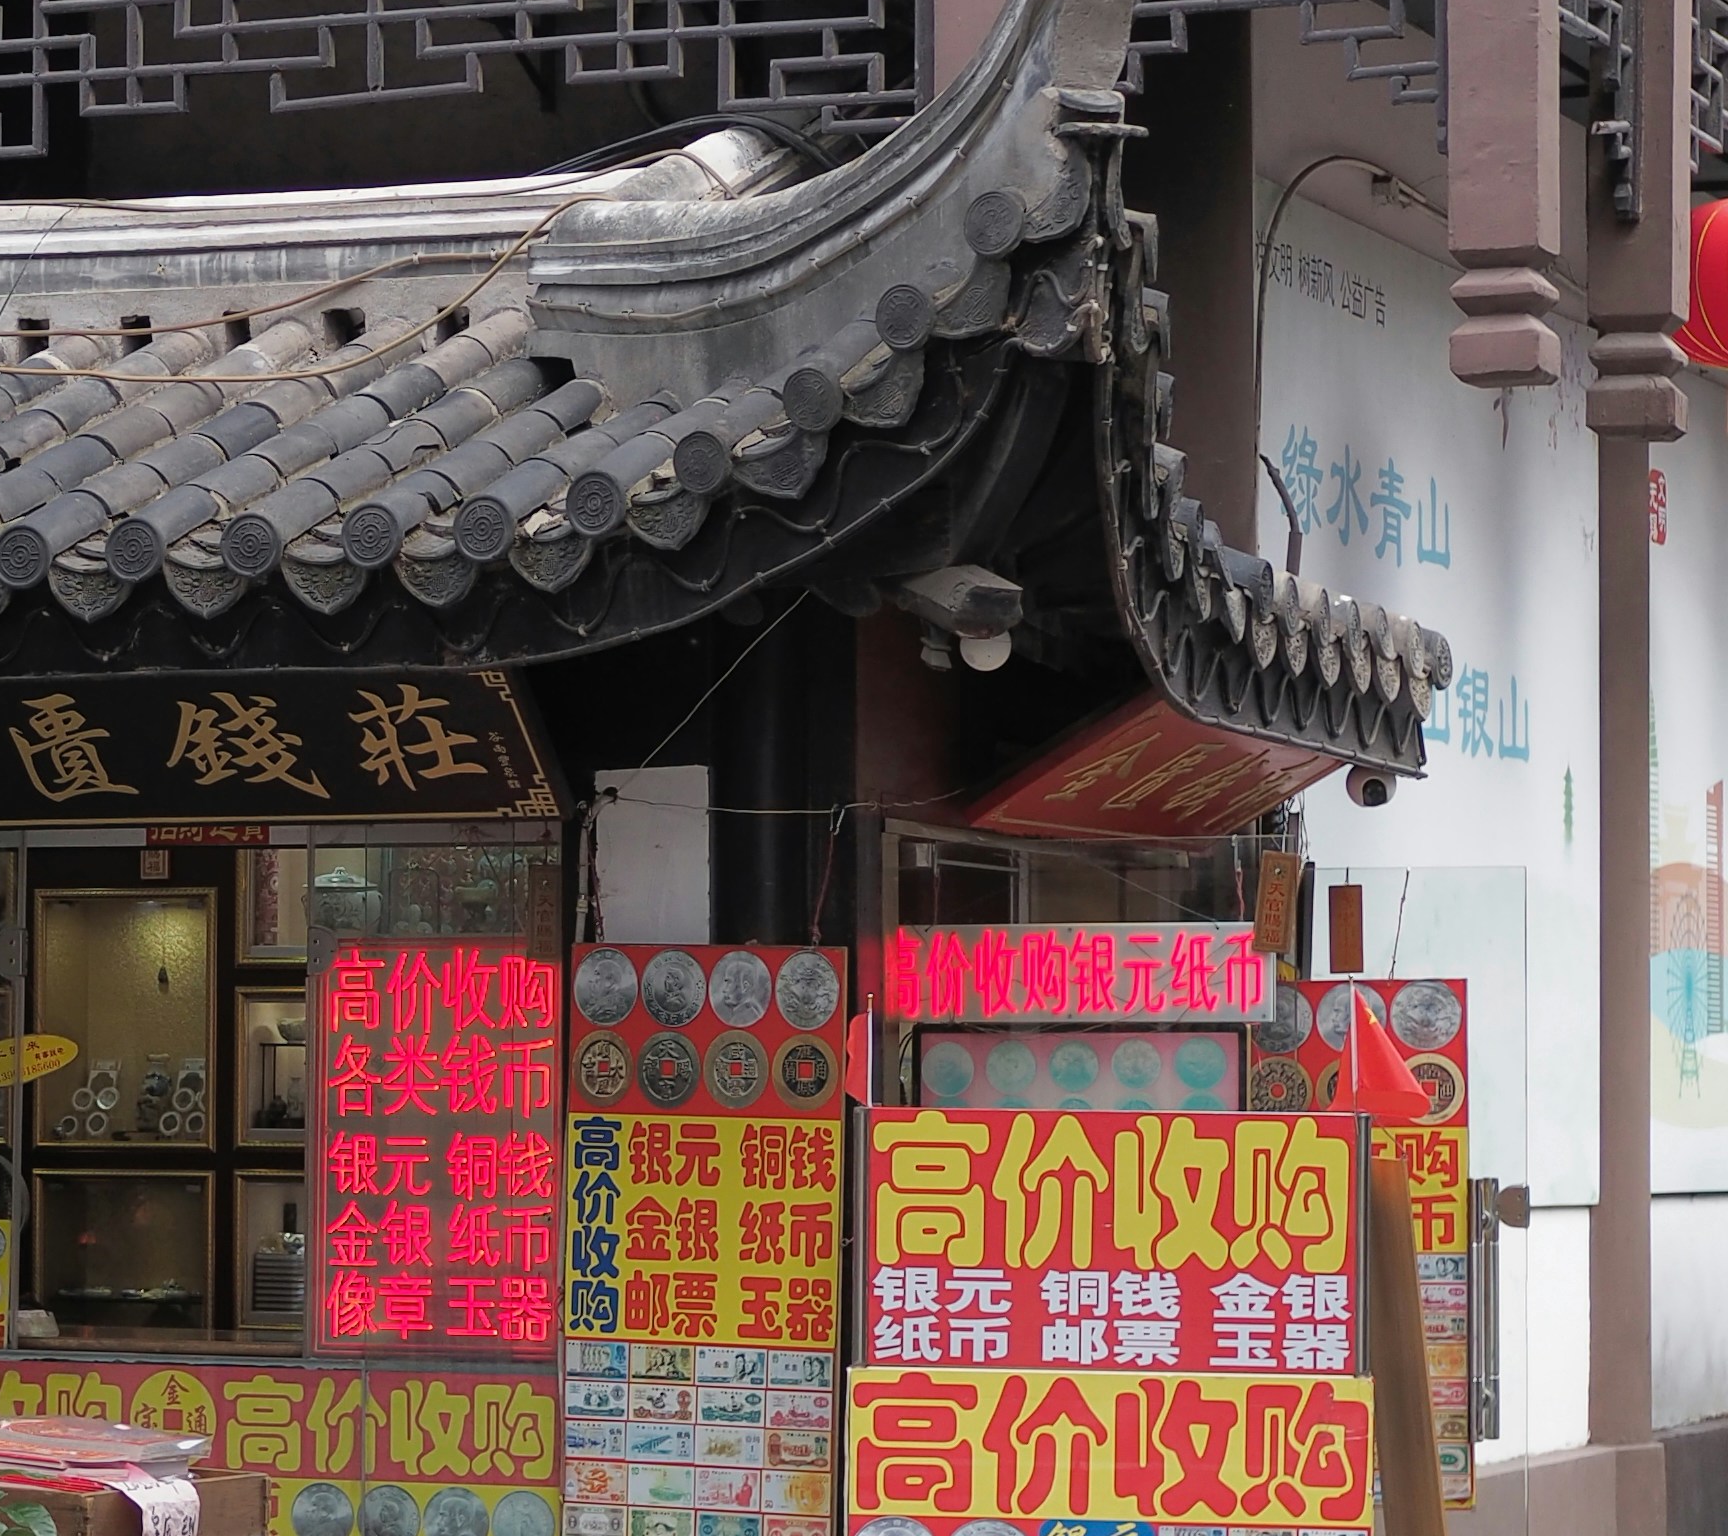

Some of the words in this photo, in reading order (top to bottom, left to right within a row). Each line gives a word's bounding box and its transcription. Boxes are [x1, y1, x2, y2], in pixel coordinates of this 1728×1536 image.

[1299, 249, 1335, 307] 树新风
[1340, 269, 1386, 328] 公益广告
[329, 948, 557, 1033] 高价收购
[885, 927, 1264, 1018] 高价收购银元纸币
[328, 1033, 556, 1119] 各类钱币
[328, 1130, 432, 1197] 银元
[446, 1131, 554, 1200] 铜钱
[629, 1121, 721, 1187] 银元
[740, 1124, 837, 1193] 铜钱
[872, 1109, 1350, 1274] 高价收购
[1372, 1129, 1459, 1190] 购
[327, 1200, 433, 1267] 金银
[446, 1203, 553, 1272] 纸币
[570, 1116, 621, 1332] 高价收购
[625, 1195, 719, 1262] 金银
[739, 1201, 833, 1267] 纸币
[326, 1269, 433, 1340] 像章
[446, 1277, 552, 1342] 玉器
[625, 1269, 718, 1337] 邮票
[737, 1277, 833, 1341] 玉器
[872, 1268, 1012, 1314] 银元
[1040, 1270, 1181, 1318] 铜钱
[1209, 1274, 1352, 1322] 金银
[874, 1316, 1010, 1362] 纸币
[1040, 1319, 1181, 1366] 邮票
[1209, 1323, 1350, 1370] 玉器
[223, 1374, 558, 1477] 高价收购
[852, 1371, 1370, 1522] 高价收购
